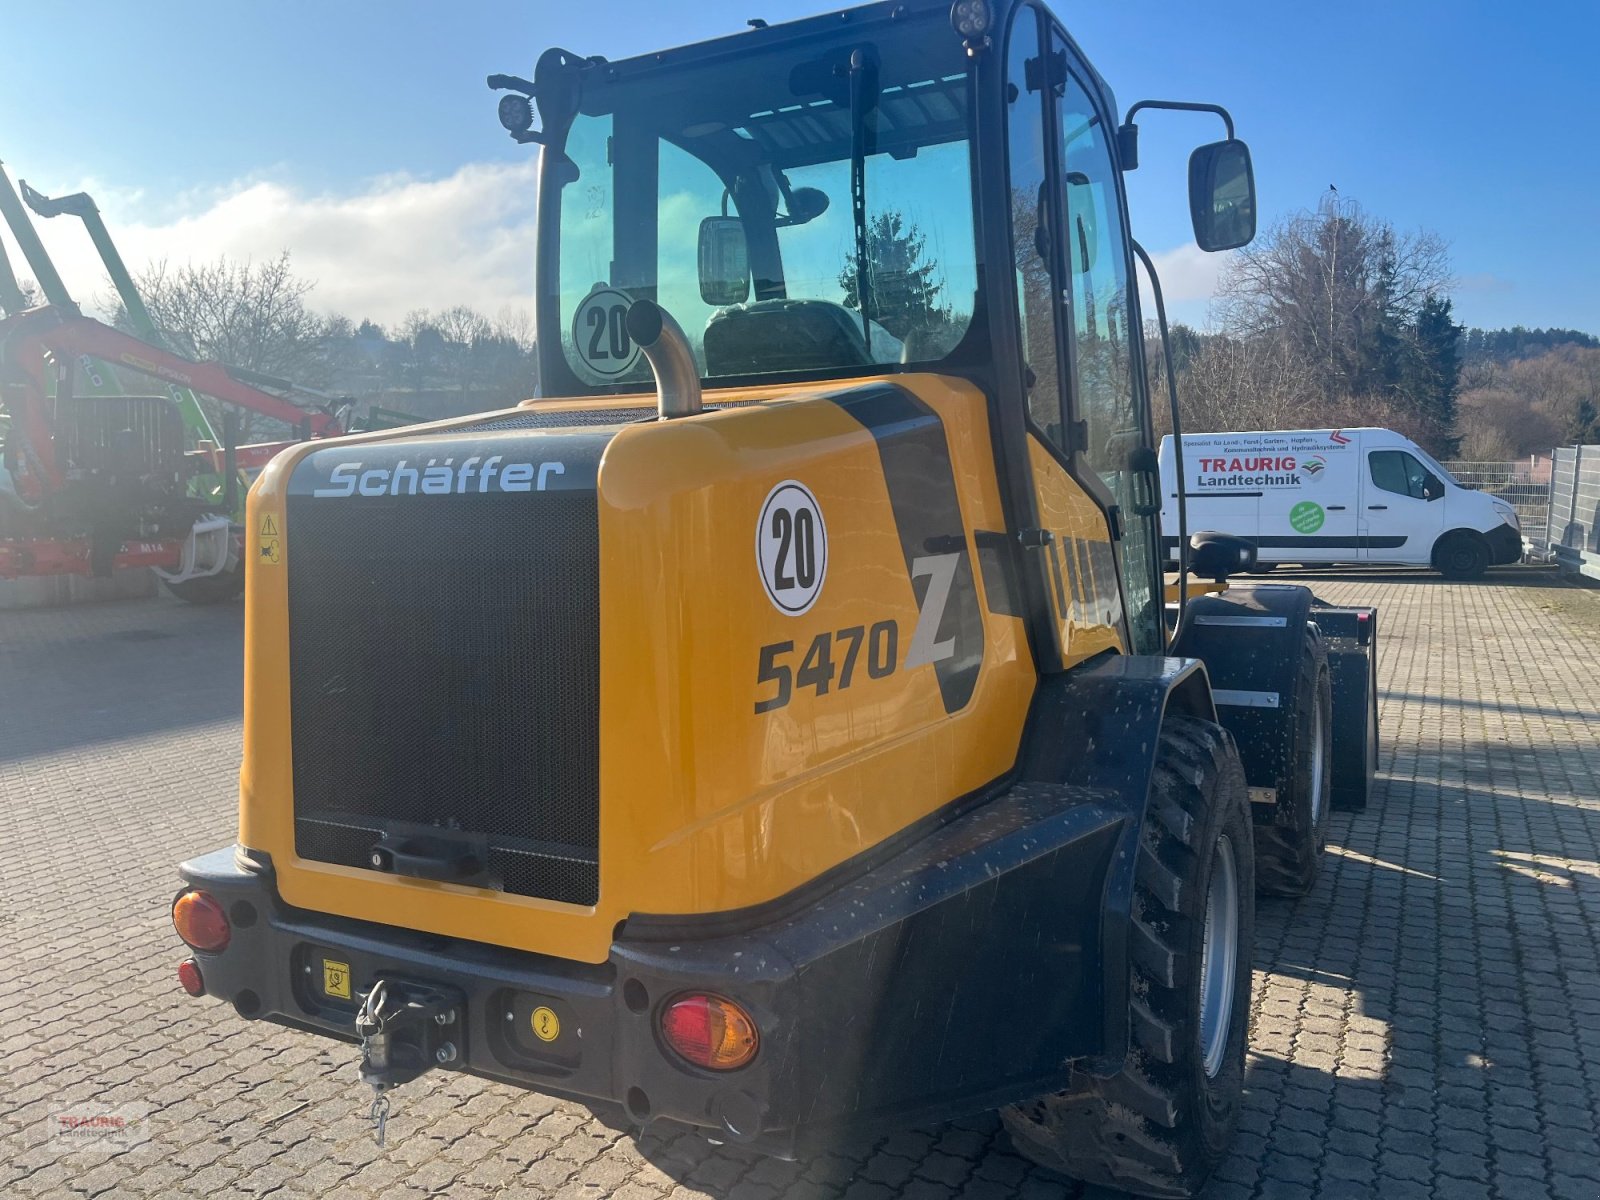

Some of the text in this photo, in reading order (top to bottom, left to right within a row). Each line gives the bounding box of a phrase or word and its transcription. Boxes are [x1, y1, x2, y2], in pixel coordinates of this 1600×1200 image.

[586, 304, 630, 360] 20
[313, 455, 565, 498] Schäffer
[1197, 473, 1301, 487] Landtechnik
[1199, 456, 1296, 473] TRAURIG
[771, 507, 816, 591] 20
[754, 619, 899, 715] 5470
